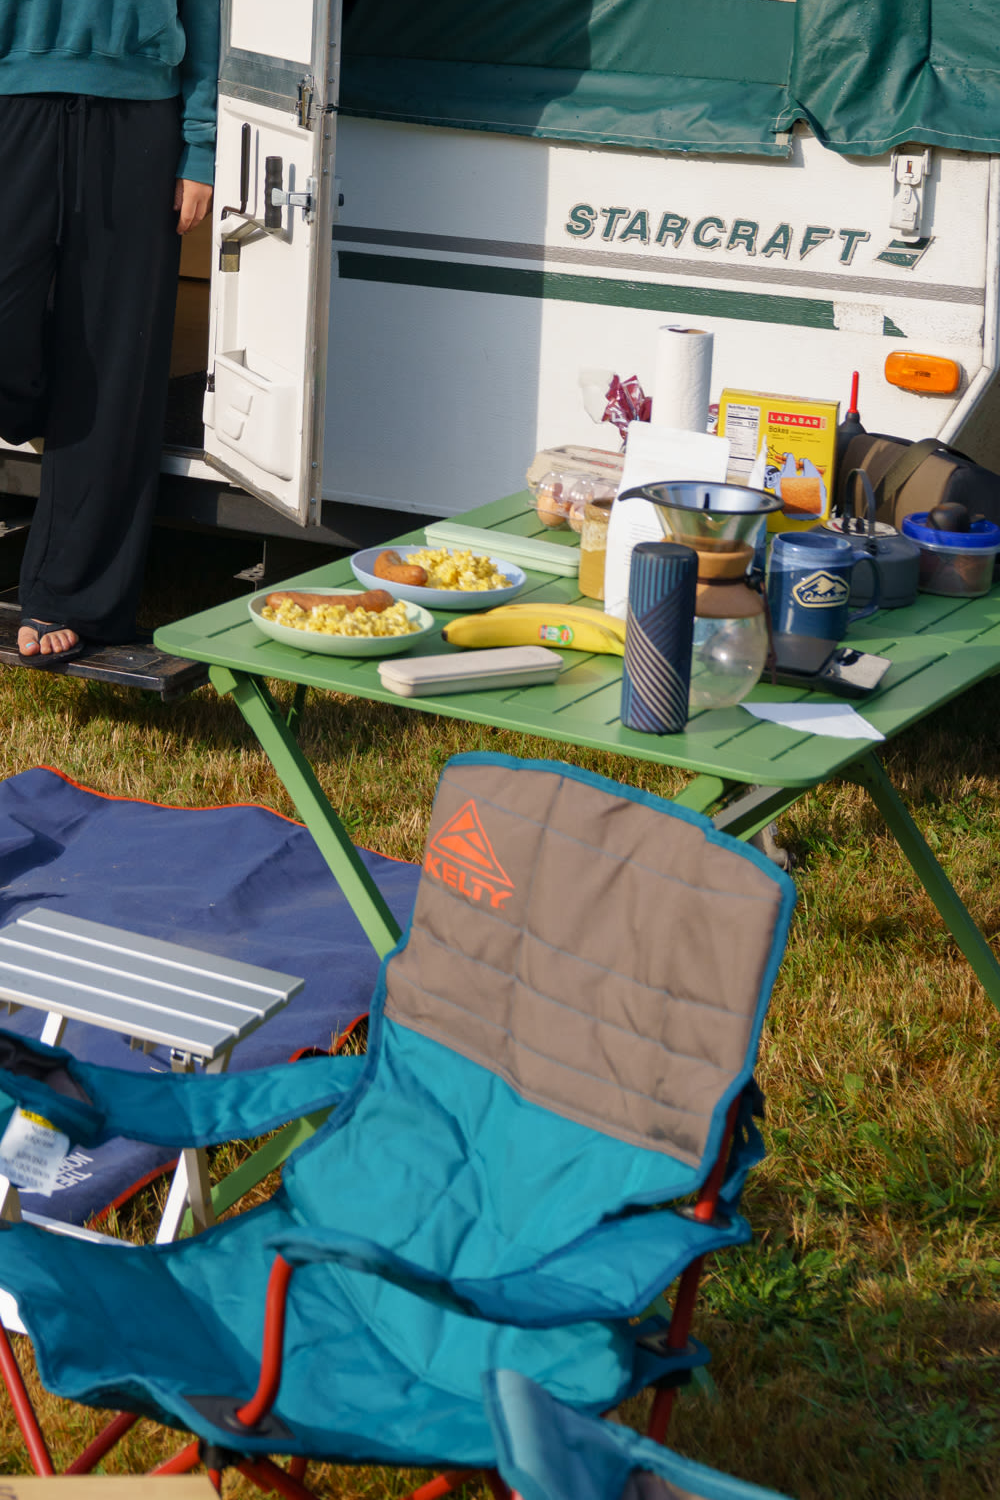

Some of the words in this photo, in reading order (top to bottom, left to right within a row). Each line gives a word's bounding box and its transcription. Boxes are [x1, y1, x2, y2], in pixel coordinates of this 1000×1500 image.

[566, 203, 870, 266] STARCRAFT
[770, 414, 819, 426] LARABAR
[425, 852, 513, 909] KELTY
